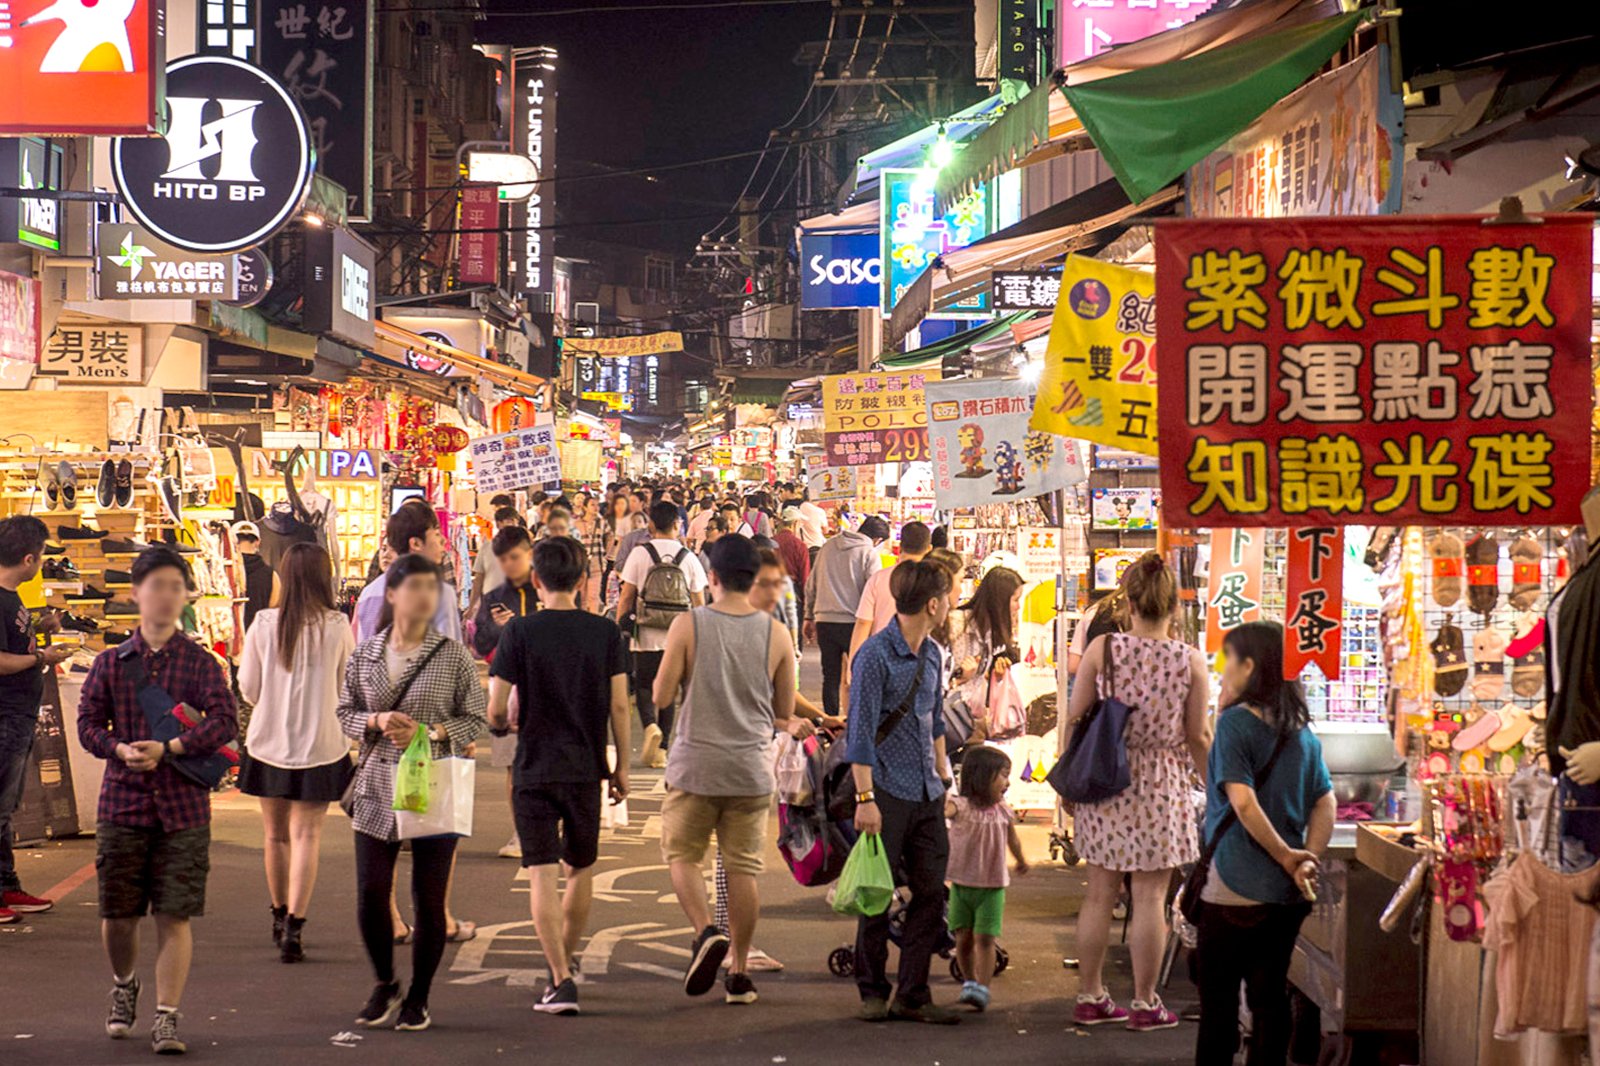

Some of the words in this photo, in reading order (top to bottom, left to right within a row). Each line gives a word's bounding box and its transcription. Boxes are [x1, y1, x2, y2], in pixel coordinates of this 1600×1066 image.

[274, 4, 354, 40] 世紀
[154, 182, 217, 200] HITO
[229, 184, 266, 201] BP
[150, 261, 226, 279] YAGER
[1184, 246, 1556, 332] 紫微斗數
[48, 331, 129, 364] 男裝
[1062, 344, 1113, 382] 一雙
[77, 365, 129, 378] Men's
[838, 374, 926, 395] 遠東百貨
[1186, 340, 1556, 426] 開運點痣
[838, 411, 928, 430] POLO
[1186, 433, 1556, 514] 知識光碟
[1287, 526, 1340, 654] 下蛋
